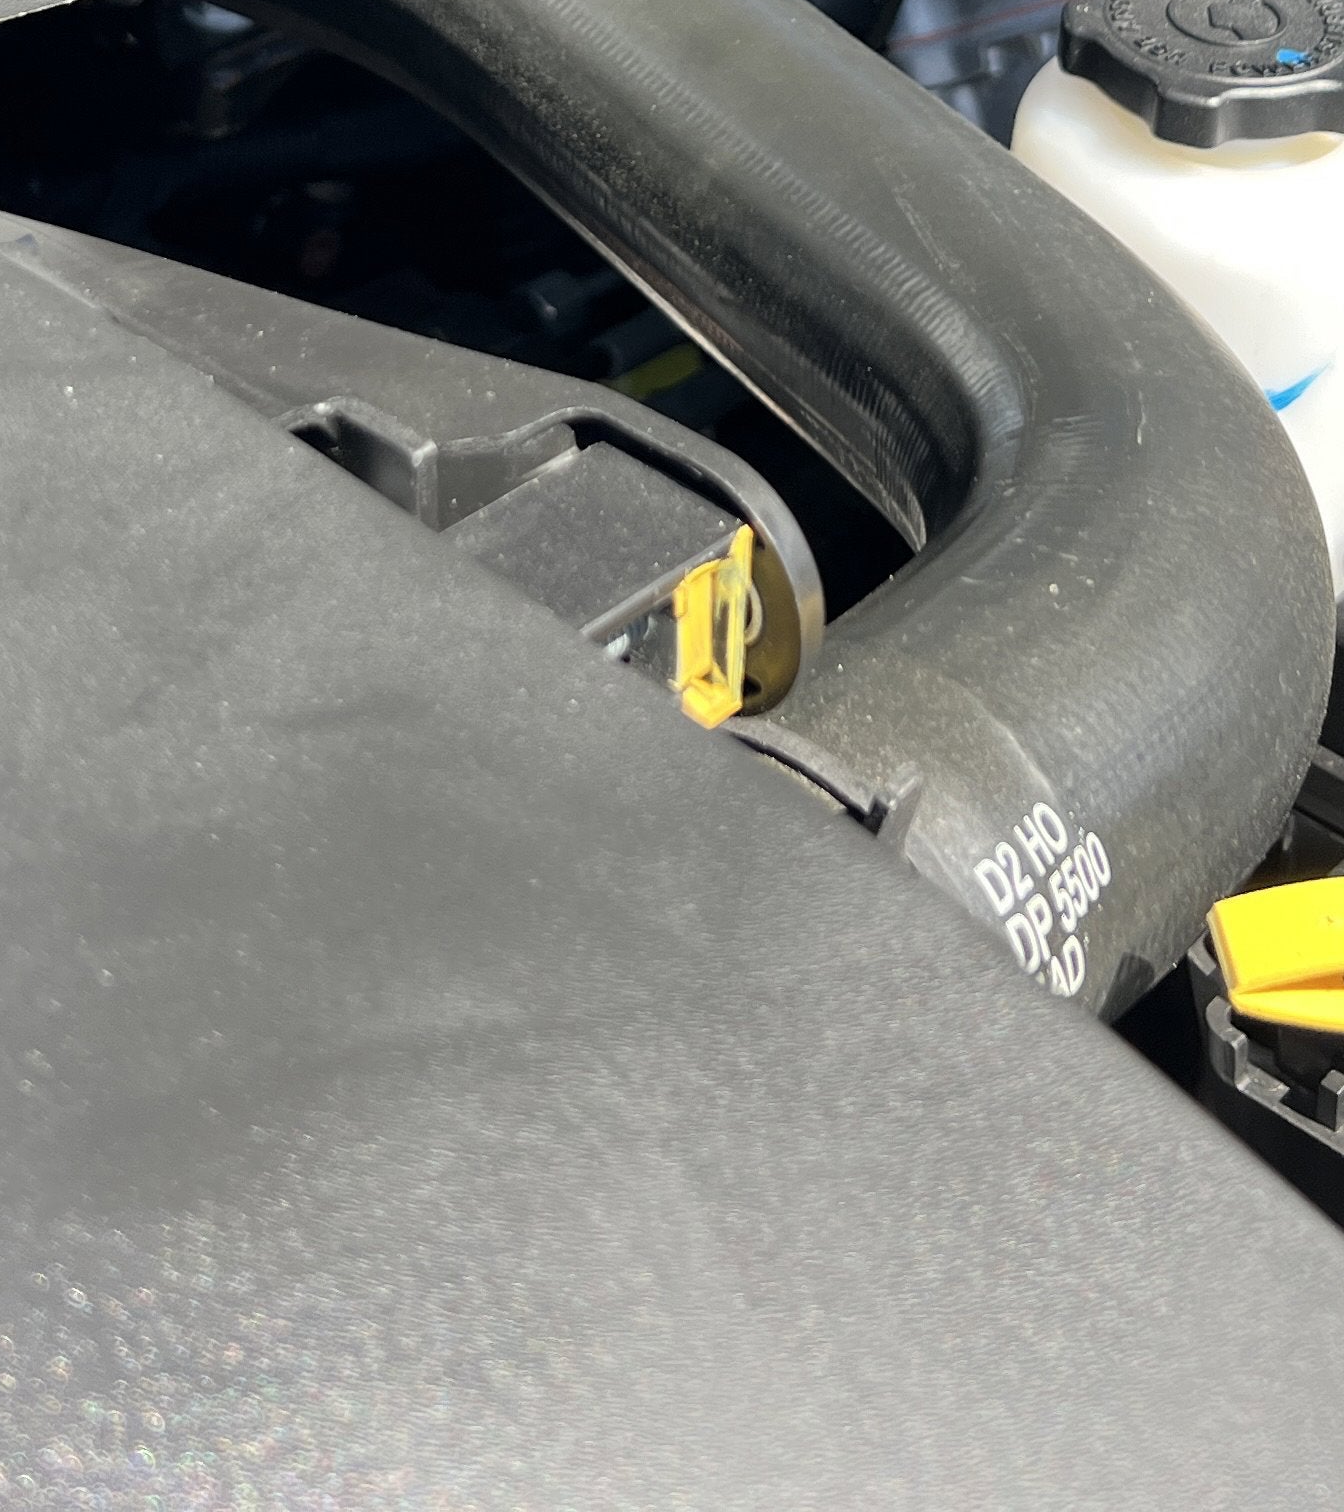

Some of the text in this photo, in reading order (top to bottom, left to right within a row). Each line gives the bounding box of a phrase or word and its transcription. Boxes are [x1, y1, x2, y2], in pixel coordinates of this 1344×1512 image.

[973, 801, 1068, 916] D2 HO
[1005, 831, 1112, 975] DP 5500
